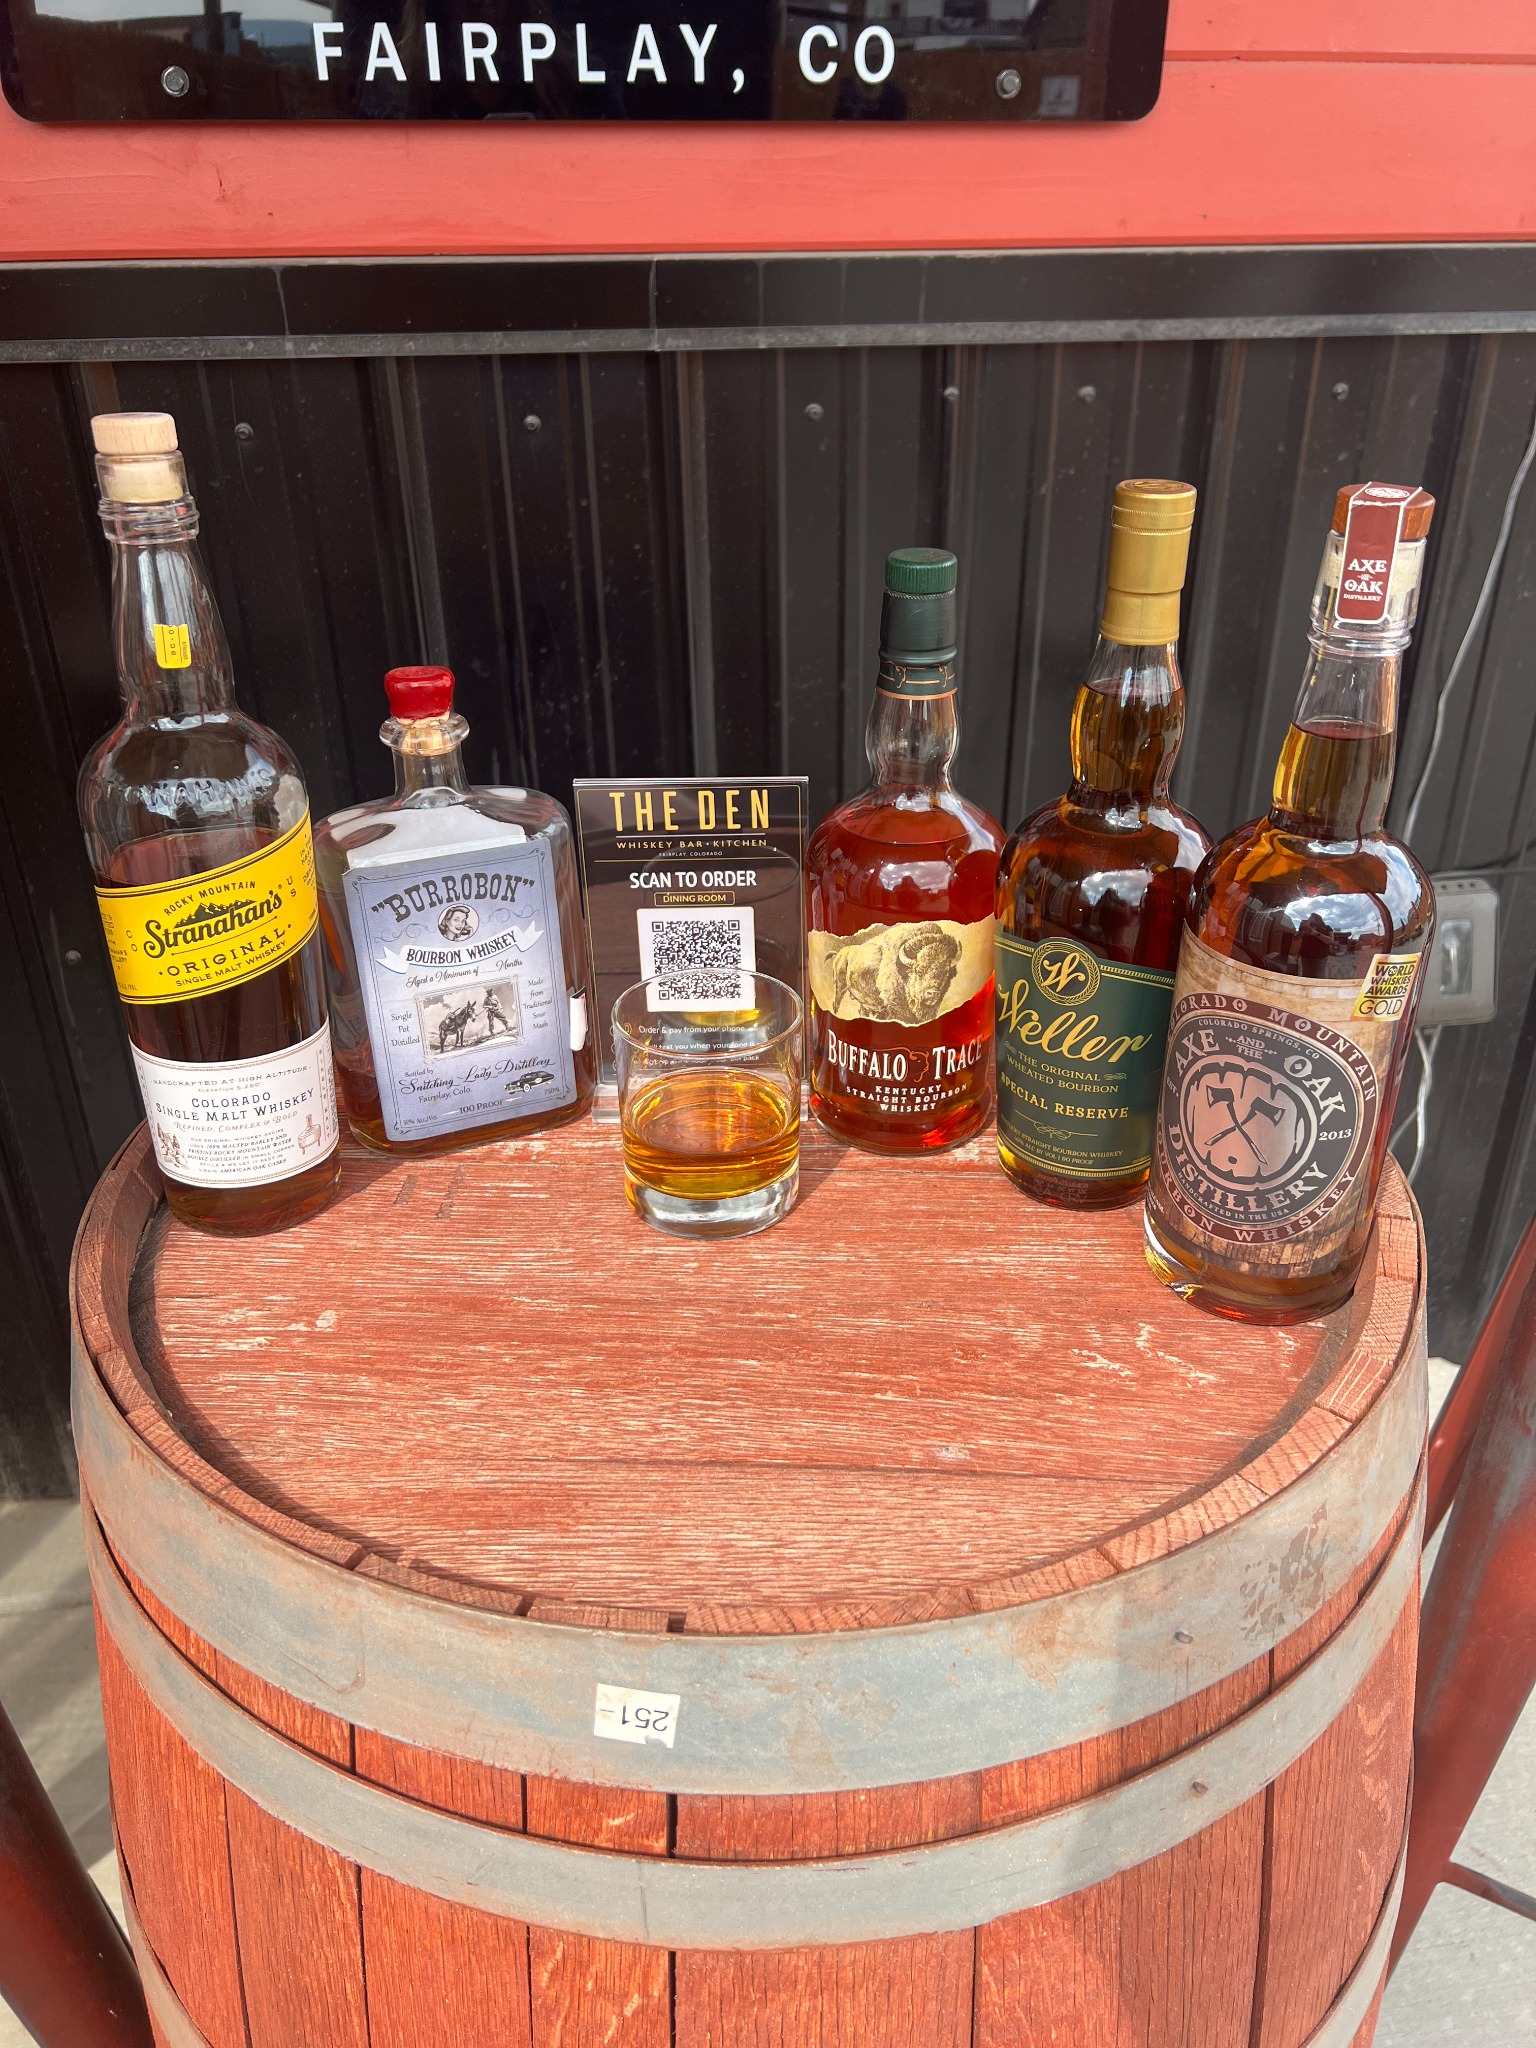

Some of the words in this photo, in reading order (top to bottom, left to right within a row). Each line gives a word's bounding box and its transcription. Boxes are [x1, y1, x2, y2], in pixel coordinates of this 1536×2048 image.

[312, 22, 748, 94] FAIRPLAY,
[798, 25, 897, 84] CO
[1347, 558, 1387, 574] AXE
[1344, 579, 1383, 595] OAK
[609, 791, 679, 832] THE
[698, 789, 769, 830] DEN
[617, 841, 673, 849] WHISKEY
[680, 840, 703, 848] BAR
[713, 839, 767, 848] KITCHEN
[629, 872, 672, 889] SCAN
[675, 872, 697, 888] TO
[701, 870, 757, 887] ORDER
[163, 894, 193, 916] ROCKY
[198, 880, 256, 899] MOUNTAIN
[662, 894, 695, 903] DINING
[697, 894, 727, 902] ROOM
[143, 890, 283, 958] Stranahan's
[166, 927, 285, 977] ORIGINAL
[405, 948, 462, 965] BOURBON
[465, 930, 518, 960] WHISKEY
[175, 972, 213, 987] SINGLE
[215, 963, 242, 978] MALT
[246, 940, 287, 966] WHISKEY
[406, 975, 428, 988] Aged
[435, 967, 472, 982] Minimum
[472, 966, 480, 977] of
[496, 958, 523, 972] Months
[1375, 964, 1415, 976] WORLD
[527, 977, 544, 987] Made
[1370, 975, 1412, 986] WHISKIES
[530, 989, 544, 998] from
[1365, 985, 1409, 996] AWARDS
[523, 997, 553, 1010] Traditional
[1359, 999, 1403, 1015] GOLD
[391, 1011, 413, 1023] Single
[532, 1010, 547, 1019] Sour
[997, 979, 1153, 1063] Weller
[398, 1024, 410, 1034] Pot
[533, 1020, 549, 1030] Mash
[638, 1025, 660, 1034] Order
[661, 1026, 668, 1034] &
[669, 1027, 682, 1035] pay
[703, 1026, 719, 1034] your
[720, 1025, 745, 1033] phone
[390, 1035, 420, 1048] Distilled
[1198, 1019, 1248, 1031] COLORADO
[1251, 1023, 1302, 1052] SPRINGS,
[1305, 1047, 1321, 1060] CO
[1237, 1034, 1266, 1049] AND
[827, 1029, 909, 1081] BUFFALO
[932, 1033, 983, 1081] TRACE
[1175, 1028, 1220, 1078] AXE
[1236, 1044, 1263, 1060] THE
[1267, 1008, 1378, 1101] MOUNTAIN
[398, 1076, 460, 1095] Snitching
[457, 1065, 498, 1085] Lady
[494, 1056, 556, 1076] Distillery
[404, 1068, 425, 1078] Bottled
[426, 1067, 434, 1077] by
[1006, 1054, 1054, 1085] WHEATED
[1058, 1079, 1119, 1093] BOURBON
[1018, 1051, 1038, 1067] THE
[1041, 1063, 1102, 1081] ORIGINAL
[153, 1079, 218, 1087] HANDCRAFTED
[238, 1074, 262, 1083] HIGH
[265, 1065, 307, 1079] ALTITUDE
[418, 1090, 453, 1105] Fairplay,
[453, 1086, 473, 1097] Colo.
[846, 1085, 907, 1104] STRAIGHT
[915, 1083, 968, 1103] BOURBON
[875, 1083, 942, 1094] KENTUCKY
[1000, 1070, 1048, 1110] SPECIAL
[1054, 1102, 1129, 1119] RESERVE
[1283, 1053, 1347, 1125] OAK
[156, 1102, 199, 1121] SINGLE
[206, 1111, 248, 1122] MALT
[254, 1088, 315, 1117] WHISKEY
[191, 1091, 271, 1108] COLORADO
[459, 1103, 475, 1114] 100
[476, 1099, 504, 1111] PROOF
[880, 1102, 936, 1112] WHISKEY
[218, 1121, 262, 1133] COMPLEX
[272, 1110, 298, 1124] BOLD
[1318, 1127, 1352, 1142] 2013
[237, 1144, 271, 1154] MOUNTAIN
[1021, 1132, 1052, 1150] STRAIGHT
[1052, 1145, 1088, 1158] BOURBON
[1089, 1150, 1124, 1158] WHISKEY
[1025, 1142, 1036, 1152] ALC
[1044, 1151, 1056, 1160] VOL
[1071, 1157, 1095, 1165] PROOF
[252, 1163, 266, 1171] OAK
[1168, 1124, 1329, 1212] DISTILLERY
[1177, 1171, 1233, 1218] HANDCRAFTED
[1233, 1210, 1246, 1219] IN
[1247, 1210, 1268, 1221] THE
[1270, 1207, 1290, 1219] USA
[1233, 1170, 1354, 1243] WHISKEY
